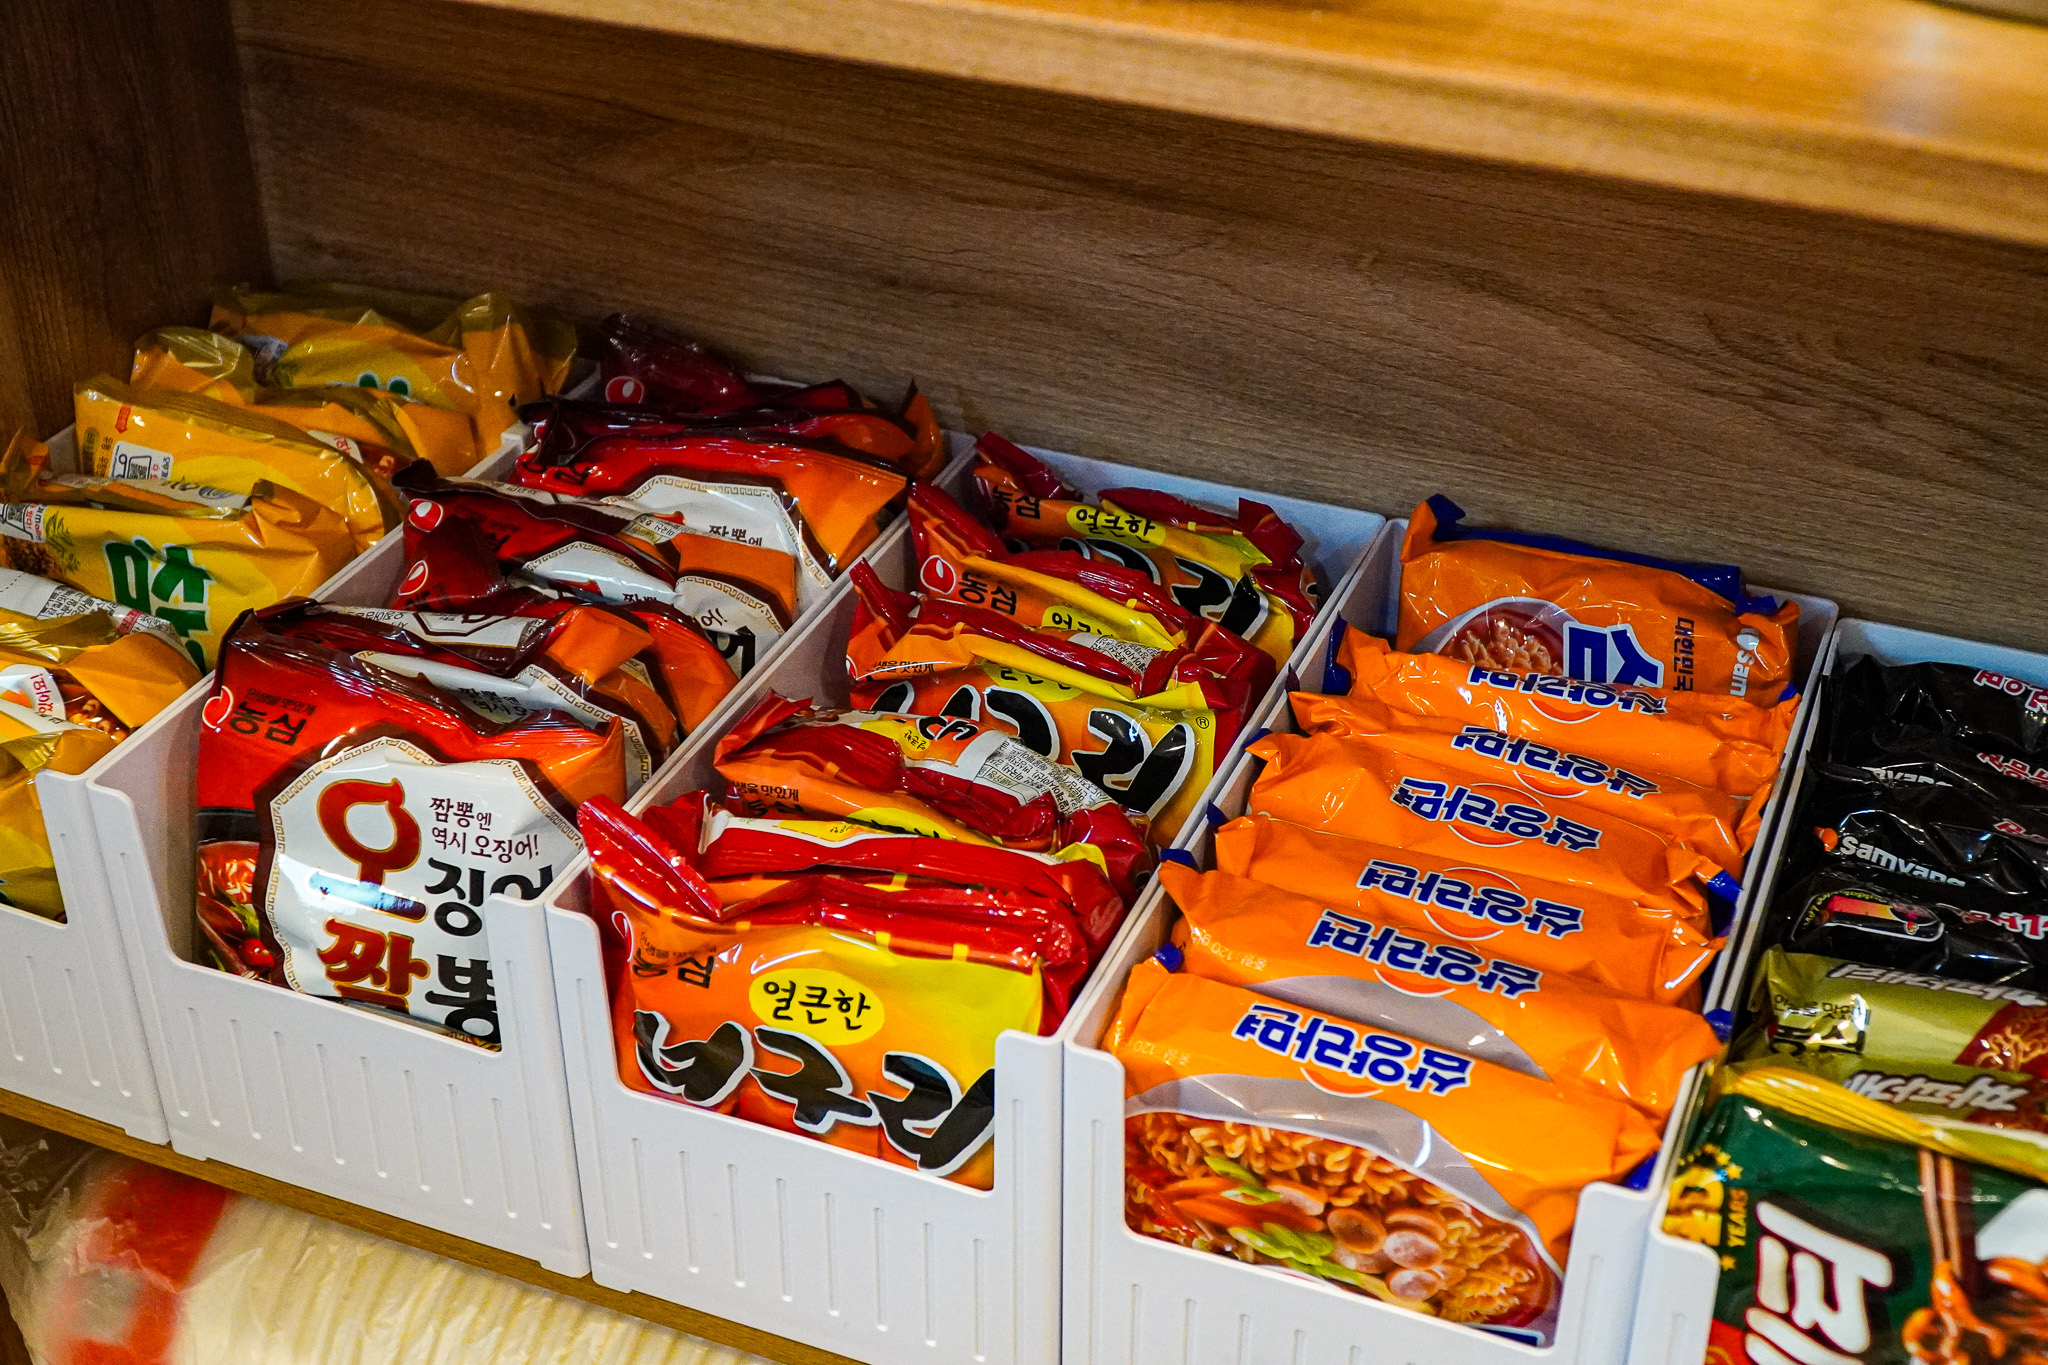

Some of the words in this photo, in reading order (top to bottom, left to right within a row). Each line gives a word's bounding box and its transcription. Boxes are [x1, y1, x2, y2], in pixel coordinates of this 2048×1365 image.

[1075, 508, 1156, 543] 얼큰한
[105, 539, 212, 668] 참
[958, 570, 1017, 616] 농심
[1673, 617, 1695, 692] 대한민국
[229, 699, 307, 746] 농심
[1451, 725, 1663, 800] 삼양라면
[429, 797, 492, 832] 짬뽕엔
[431, 827, 467, 854] 역시
[470, 834, 540, 862] 오징어!
[1392, 777, 1603, 853] 삼양라면
[1358, 859, 1585, 939] 삼양라면
[1306, 909, 1544, 999] 삼양라면
[763, 979, 871, 1030] 얼큰한
[1231, 1003, 1475, 1097] 삼양라면
[634, 1011, 995, 1177] 너구리
[1843, 1071, 2029, 1112] 짜파게
[1726, 1188, 1749, 1249] YEARS
